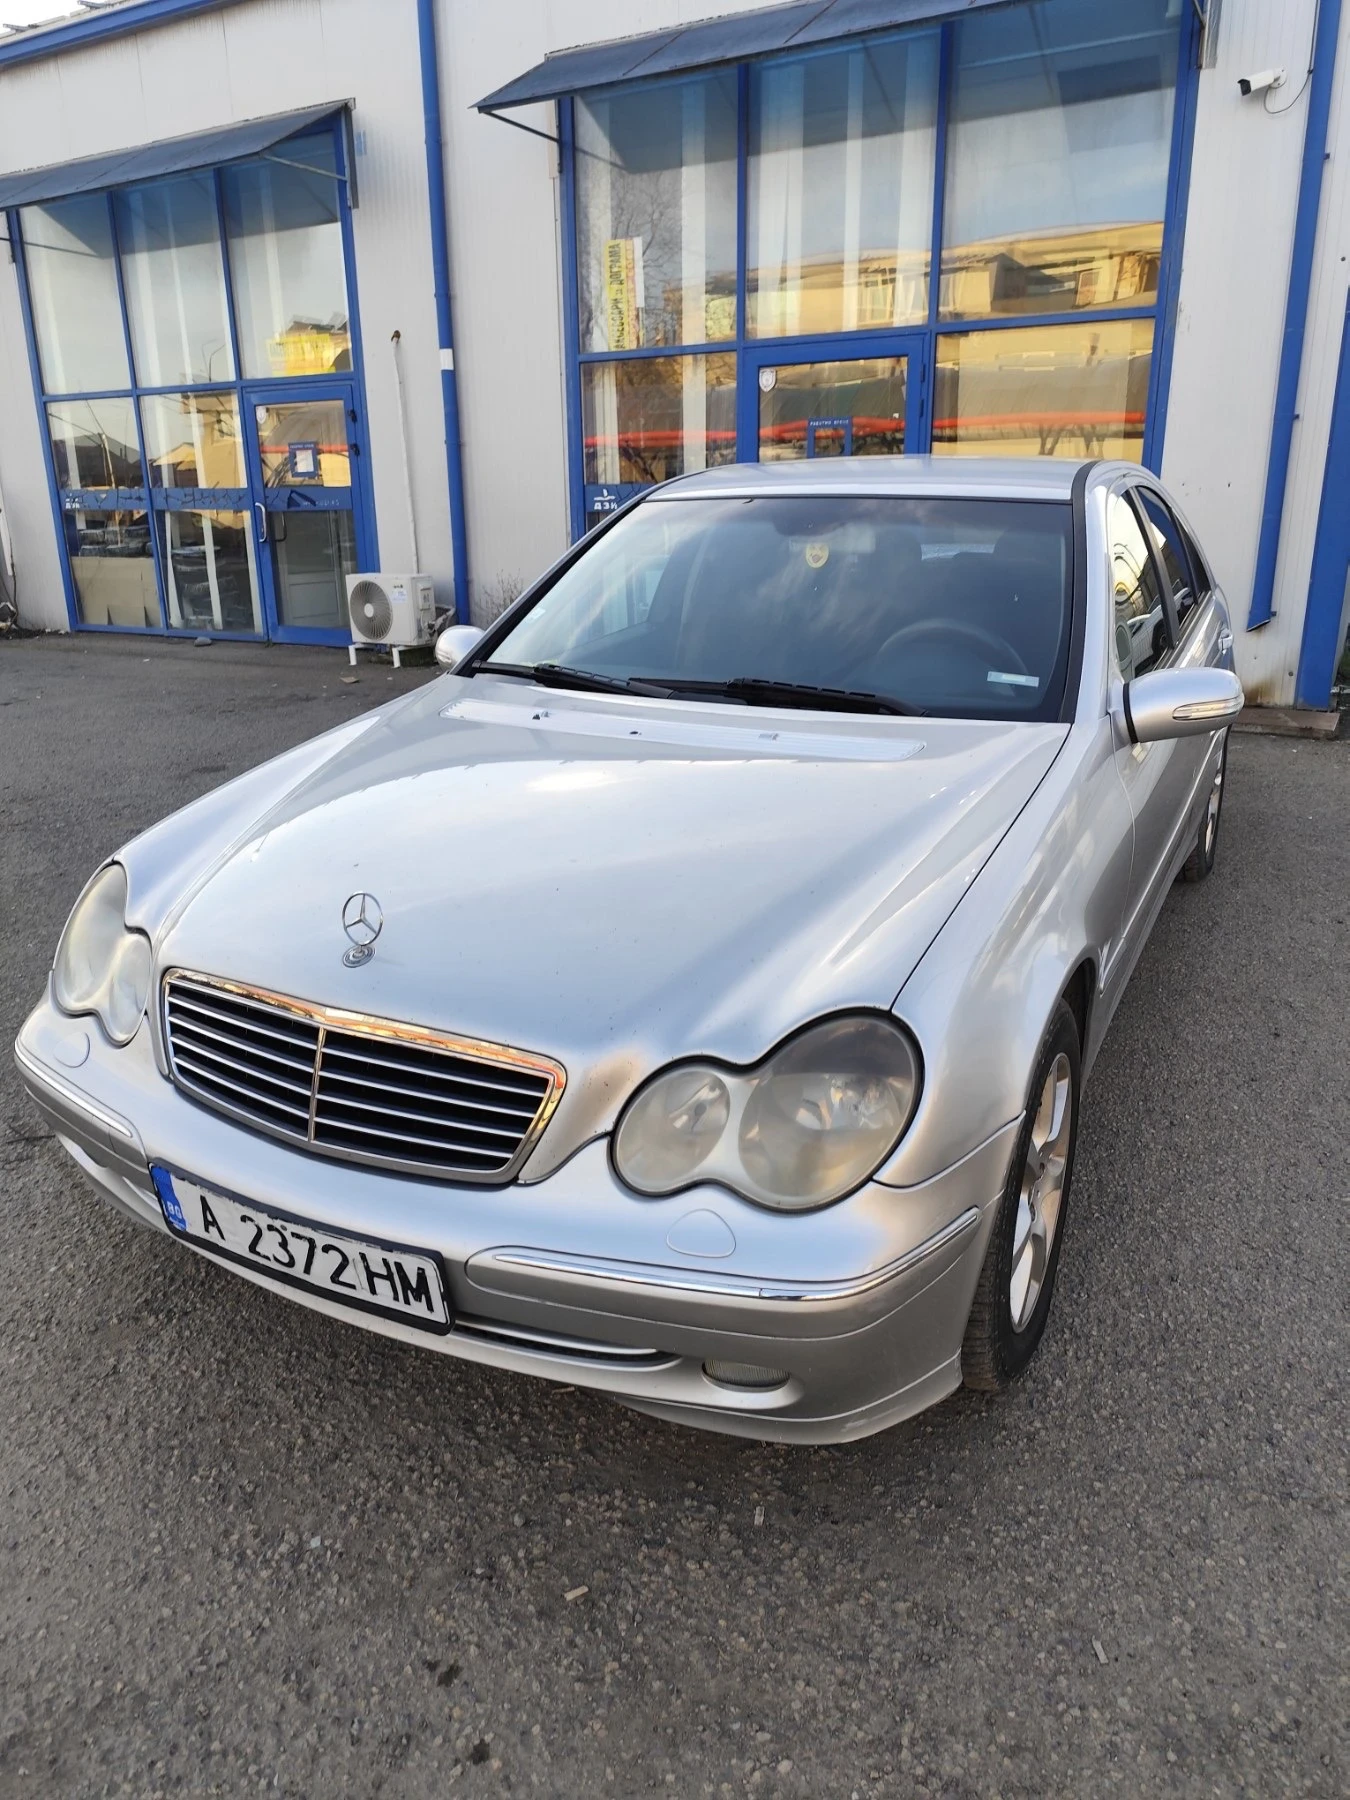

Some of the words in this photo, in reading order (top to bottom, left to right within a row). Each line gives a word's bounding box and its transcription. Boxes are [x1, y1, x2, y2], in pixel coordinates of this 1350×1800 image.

[608, 243, 624, 285] ДОГРАМА
[594, 501, 618, 510] ДЗИ
[167, 1201, 183, 1219] BG
